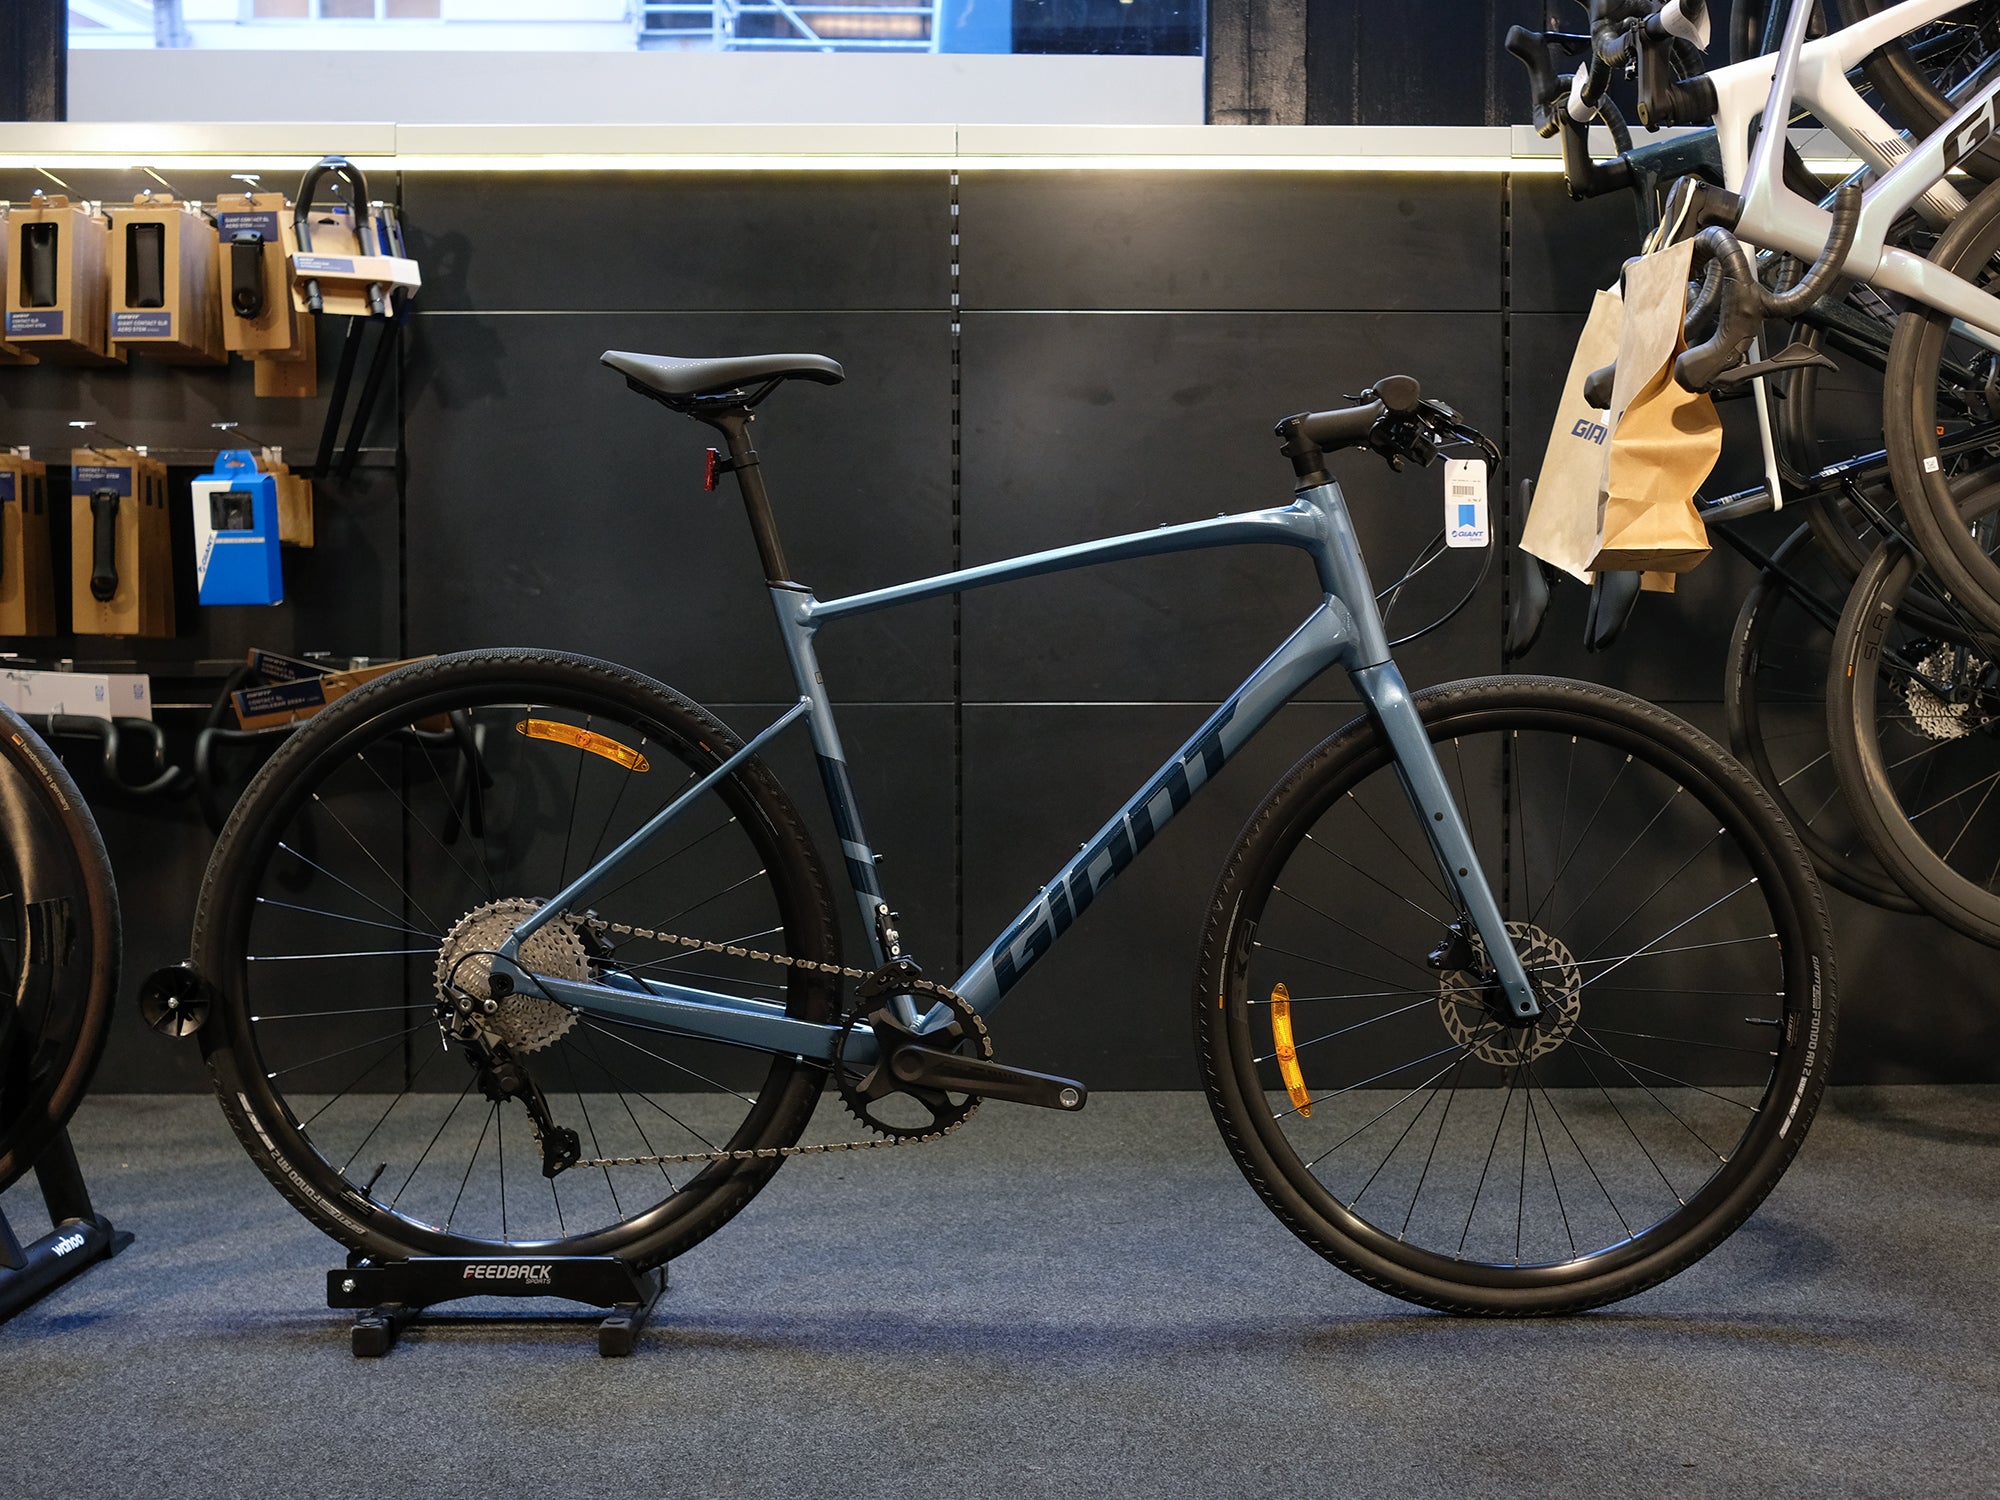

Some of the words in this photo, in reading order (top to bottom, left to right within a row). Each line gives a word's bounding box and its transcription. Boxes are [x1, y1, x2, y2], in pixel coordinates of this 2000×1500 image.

[21, 742, 48, 776] handmade
[46, 774, 53, 783] in
[49, 782, 71, 811] germany
[993, 697, 1240, 1001] GIANT
[1808, 1010, 1820, 1050] FONDO
[1804, 1050, 1816, 1068] AR
[1802, 1067, 1812, 1077] 2
[270, 1149, 280, 1160] 2
[287, 1170, 321, 1203] FONDO
[51, 1233, 85, 1257] wahoo
[463, 1265, 552, 1279] FEEDBACK
